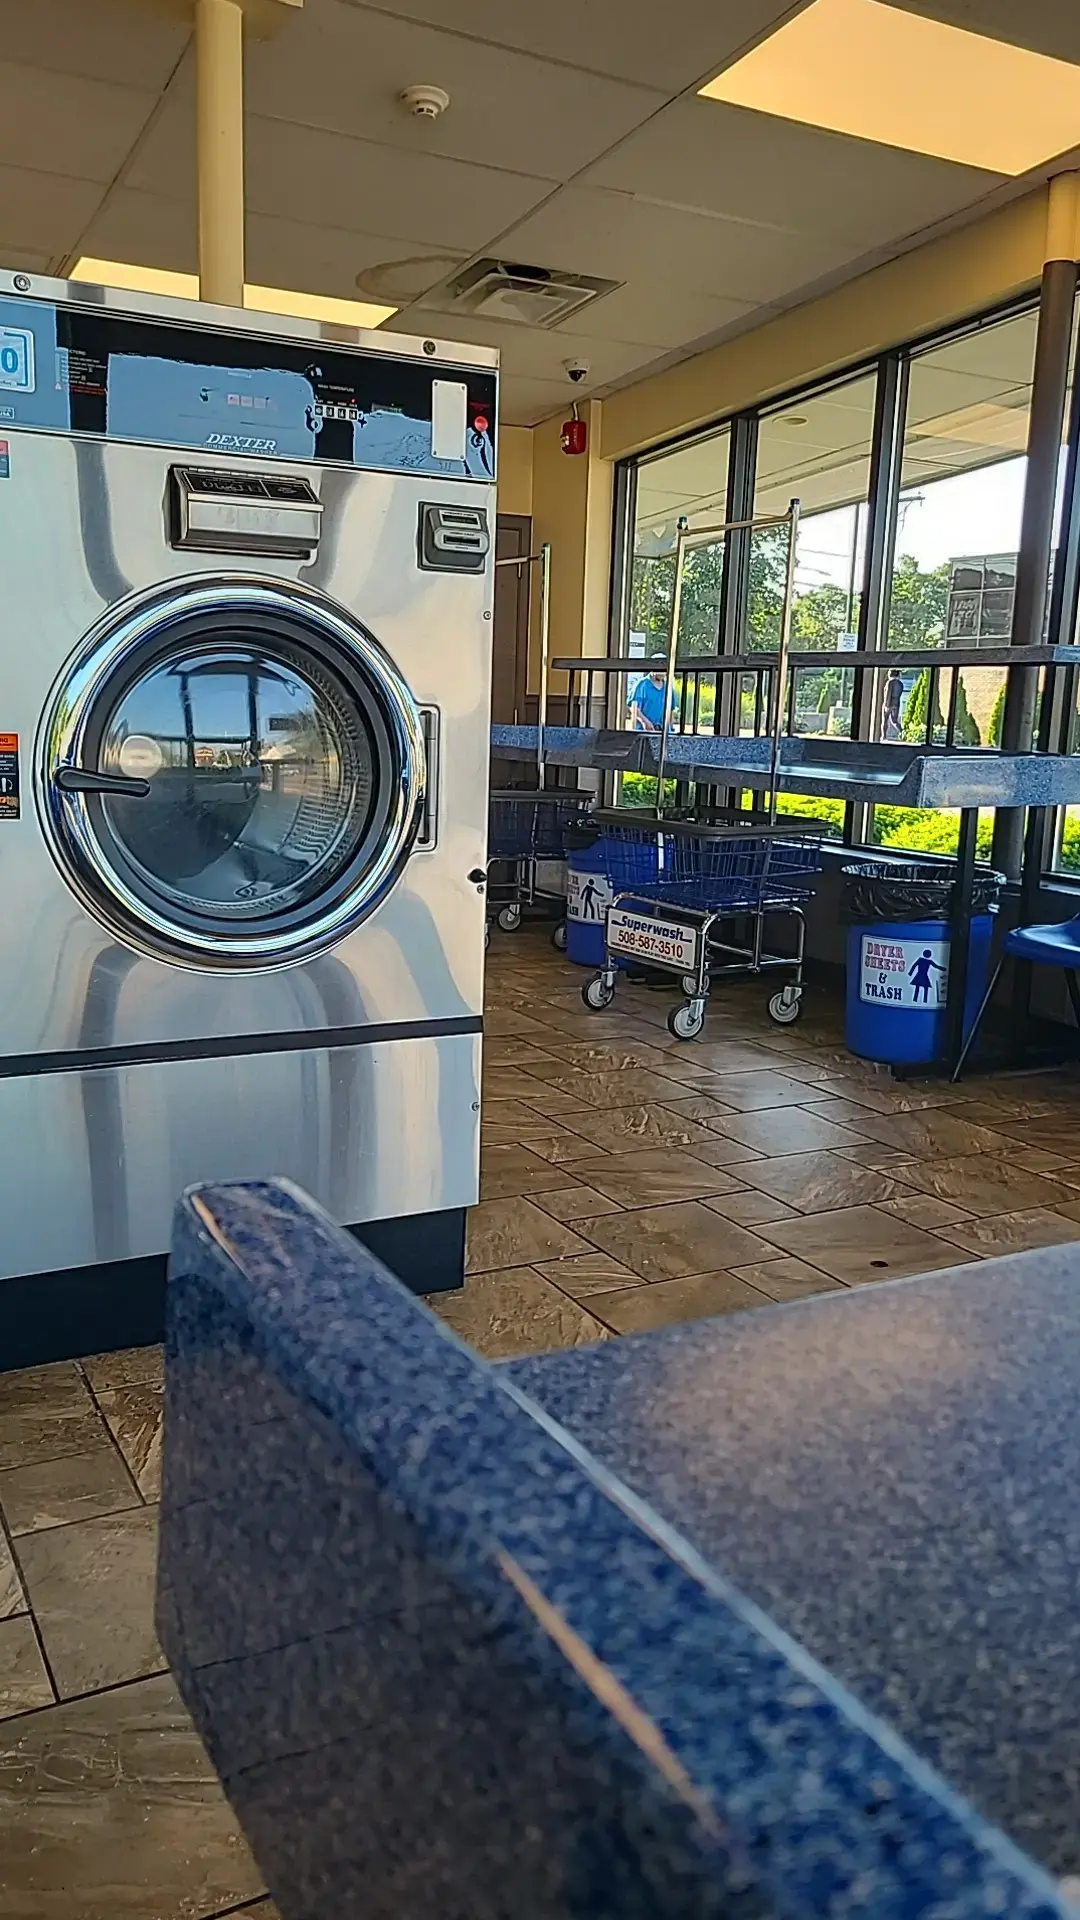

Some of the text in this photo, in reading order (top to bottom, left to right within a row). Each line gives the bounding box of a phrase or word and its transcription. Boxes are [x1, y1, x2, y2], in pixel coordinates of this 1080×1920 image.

[205, 433, 277, 450] DEXTER
[612, 915, 692, 943] Superwash
[618, 929, 684, 958] 508-587-3510
[866, 942, 904, 959] DRYER
[864, 955, 906, 973] SHEETS
[878, 972, 888, 984] &
[865, 982, 903, 1001] TRASH
